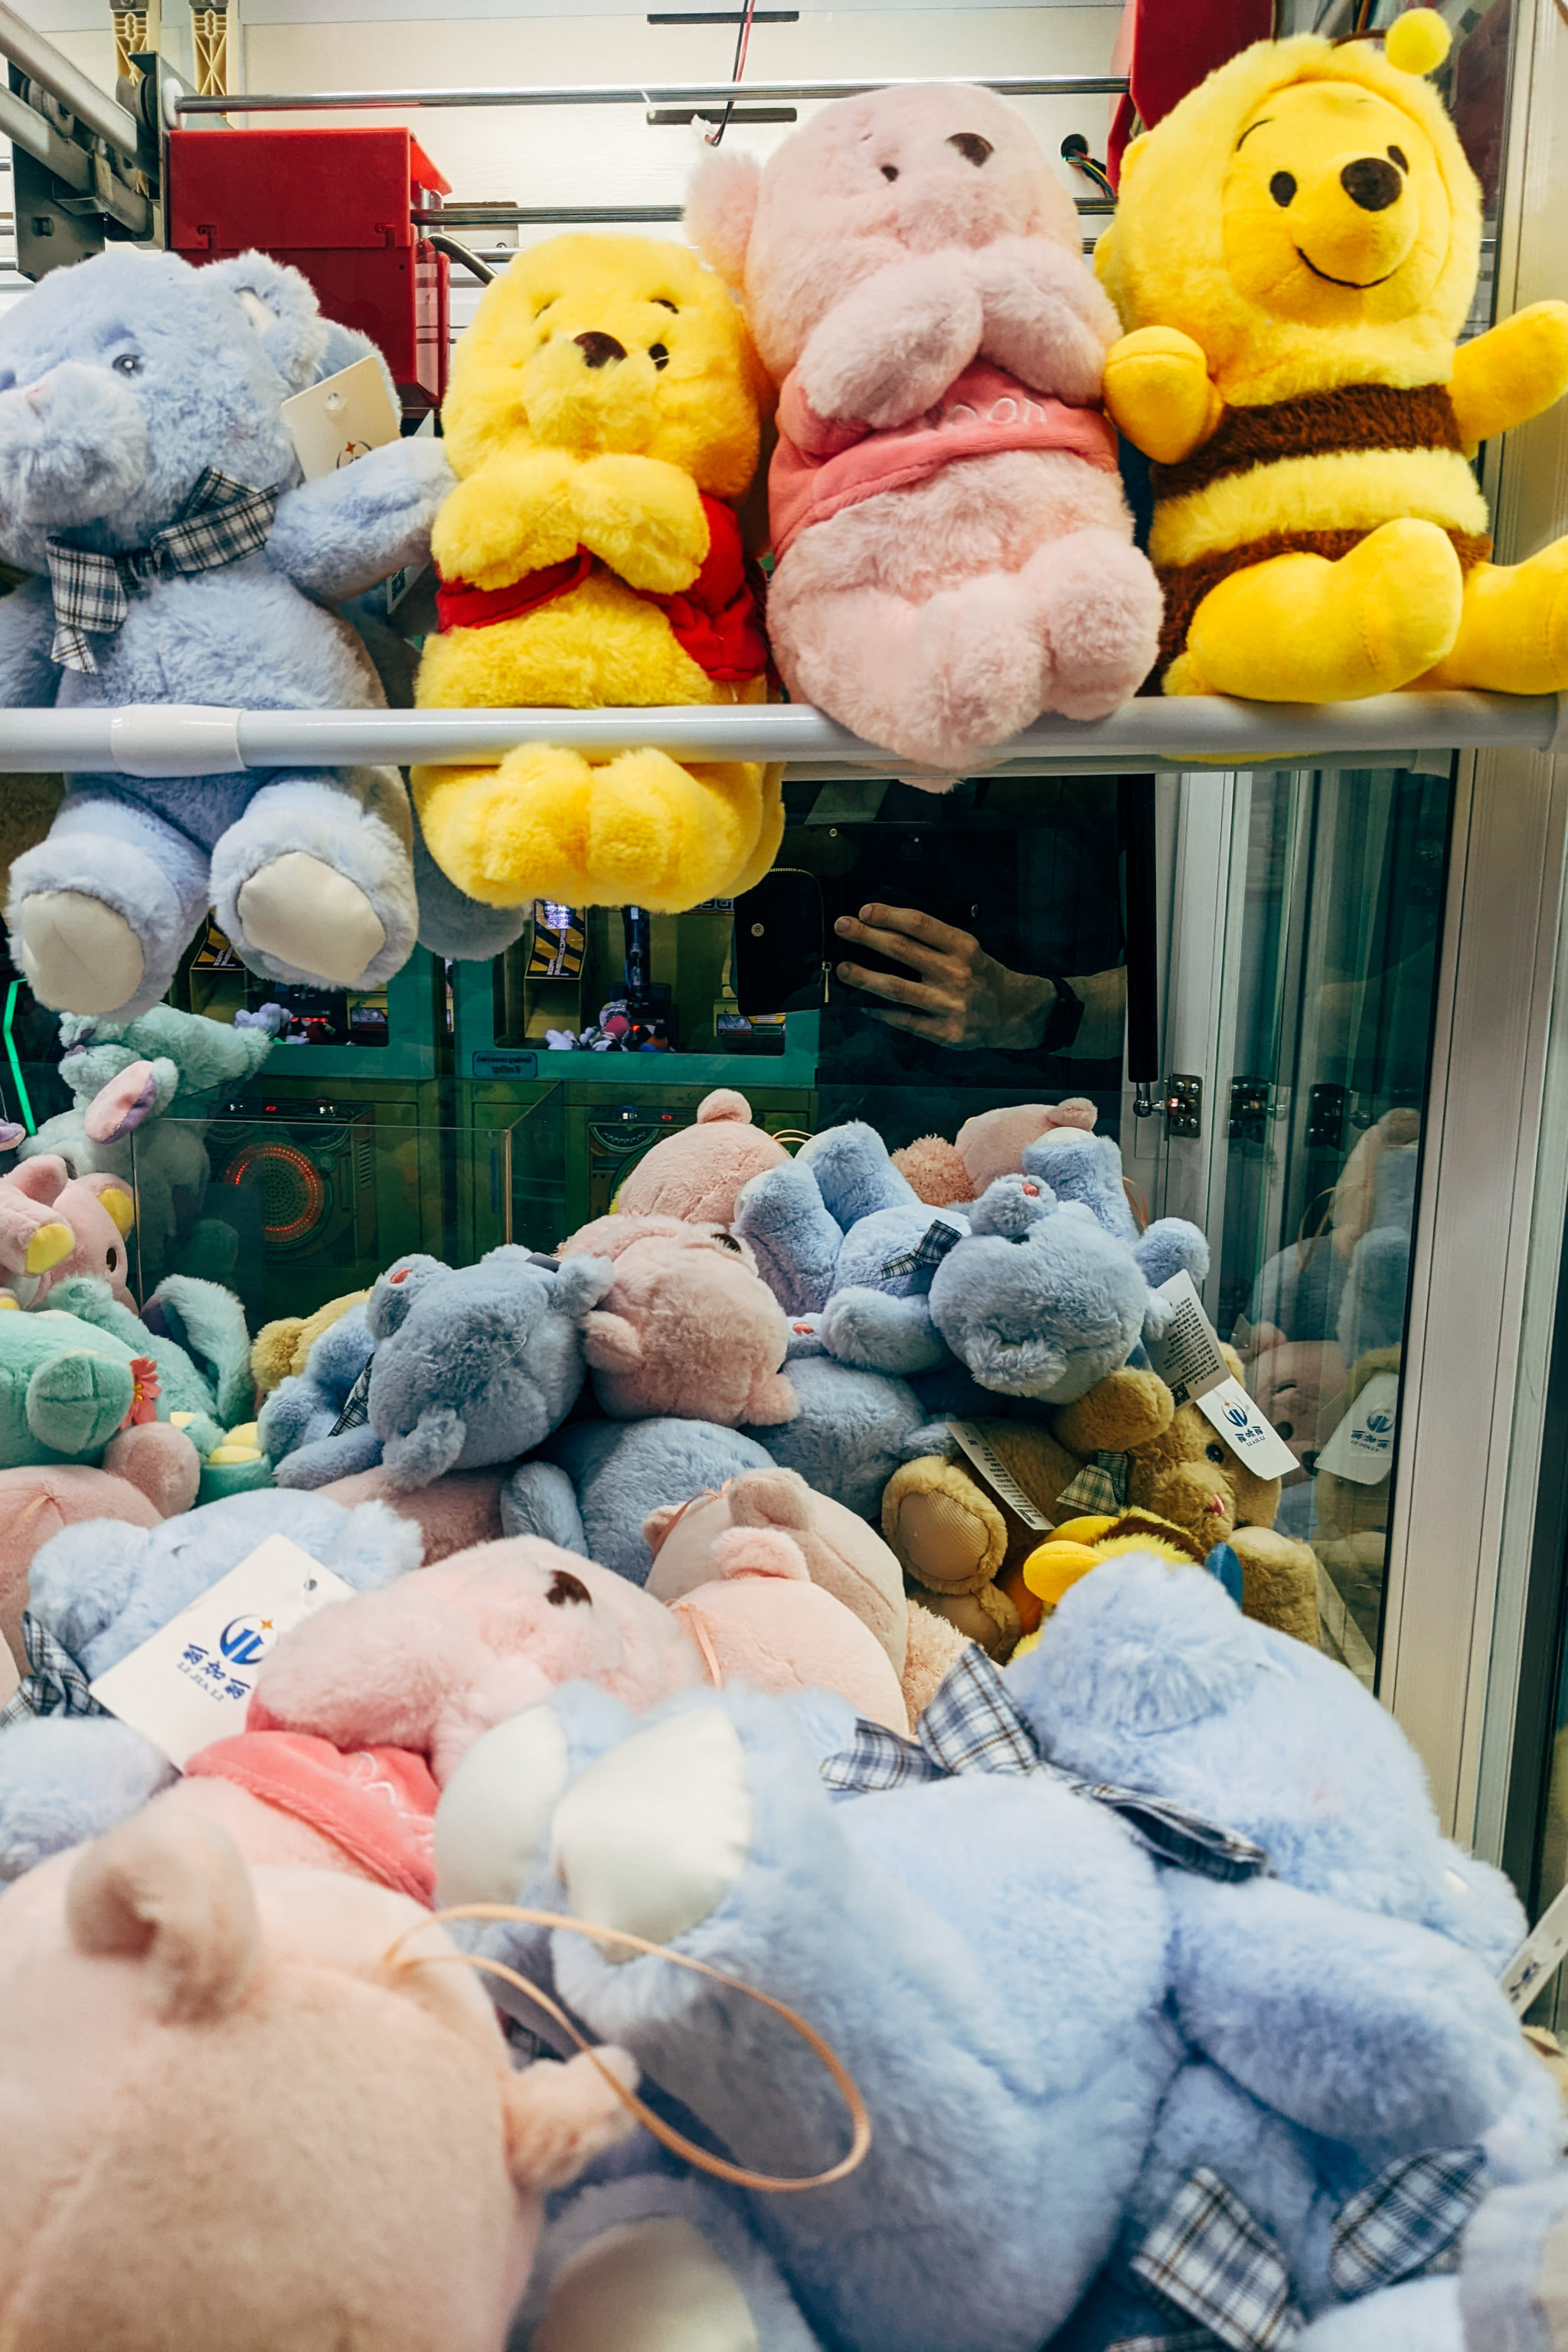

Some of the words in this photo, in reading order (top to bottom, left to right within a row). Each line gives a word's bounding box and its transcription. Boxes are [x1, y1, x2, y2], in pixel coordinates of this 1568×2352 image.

[177, 1661, 191, 1674] LI
[190, 1674, 209, 1691] JIA
[210, 1689, 224, 1702] LI
[183, 1643, 251, 1700] 丽加丽
